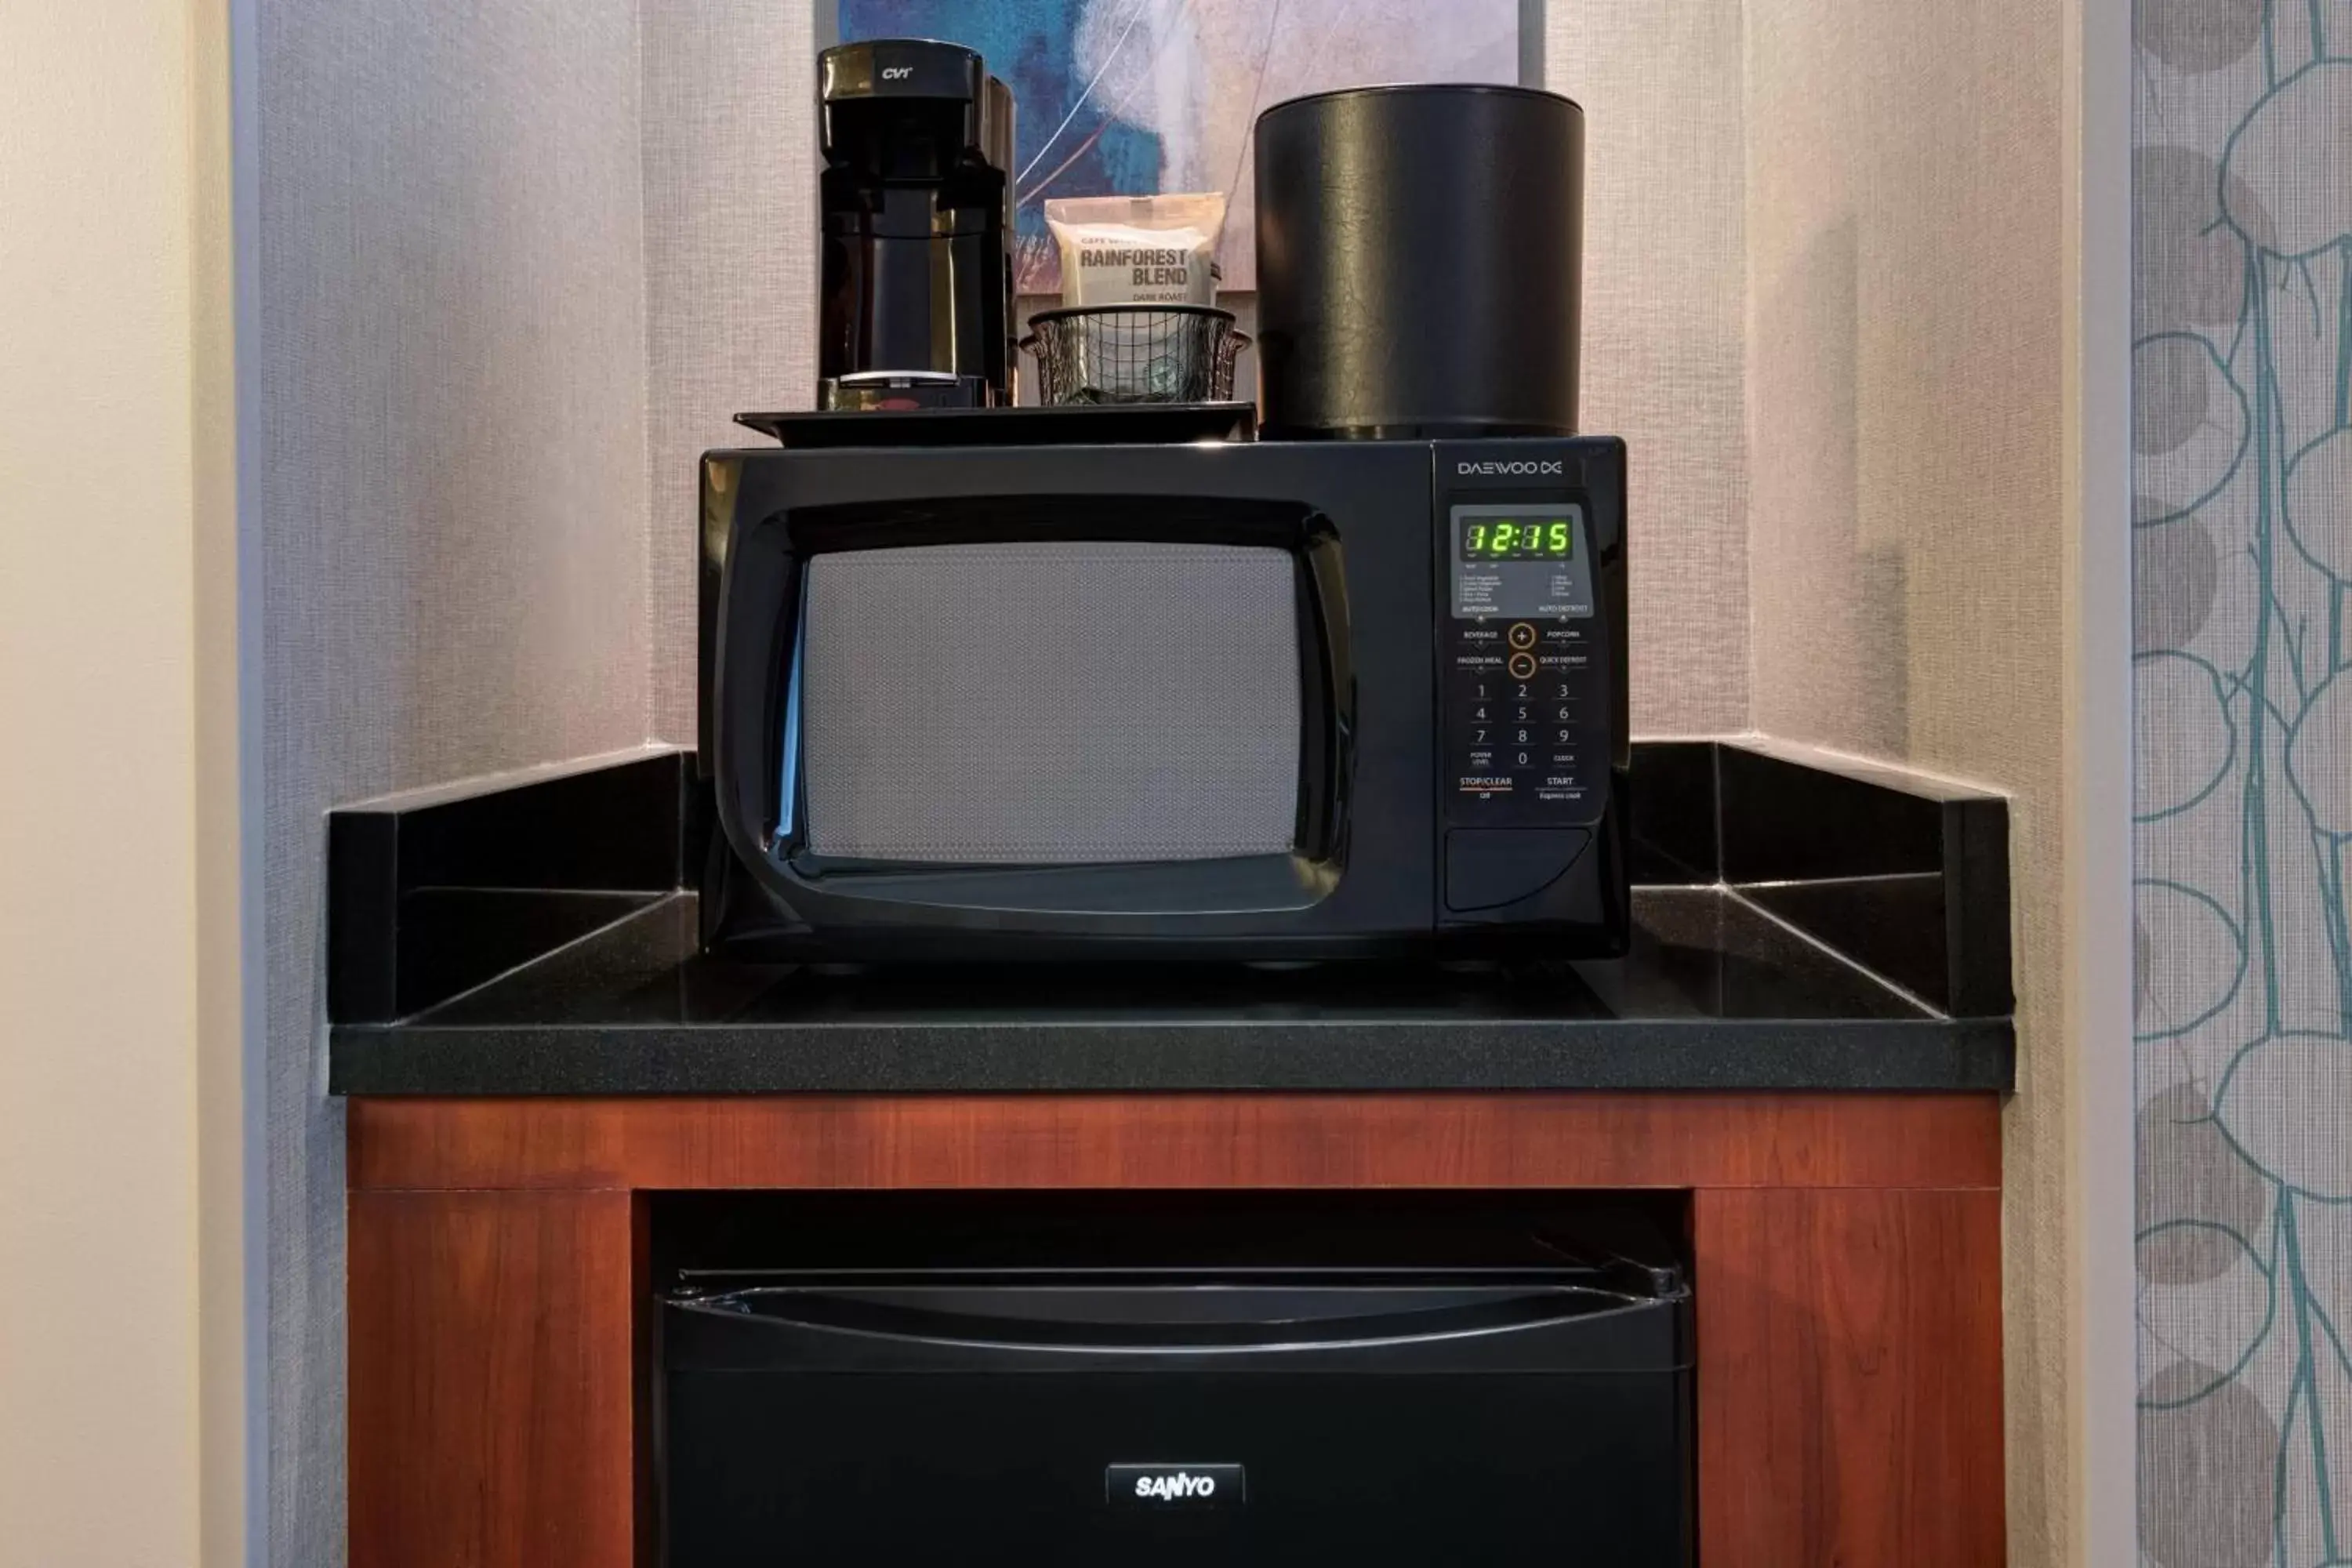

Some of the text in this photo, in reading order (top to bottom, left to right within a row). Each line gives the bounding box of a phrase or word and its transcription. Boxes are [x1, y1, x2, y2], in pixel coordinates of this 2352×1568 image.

[1080, 249, 1189, 267] RAINFOREST
[1132, 267, 1188, 286] BLEND
[1133, 292, 1188, 302] DARK ROAST
[1457, 461, 1538, 474] DAEWOO
[1473, 523, 1568, 552] 12:15
[1478, 684, 1485, 697] 1
[1518, 684, 1528, 697] 2
[1559, 684, 1569, 697] 3
[1476, 707, 1486, 720] 4
[1518, 707, 1527, 720] 5
[1559, 707, 1569, 720] 6
[1476, 730, 1486, 742] 7
[1518, 730, 1528, 742] 8
[1559, 730, 1569, 742] 9
[1519, 752, 1528, 764] 0
[1460, 777, 1512, 786] STOP/CLEAR
[1135, 1472, 1215, 1501] SANYO
